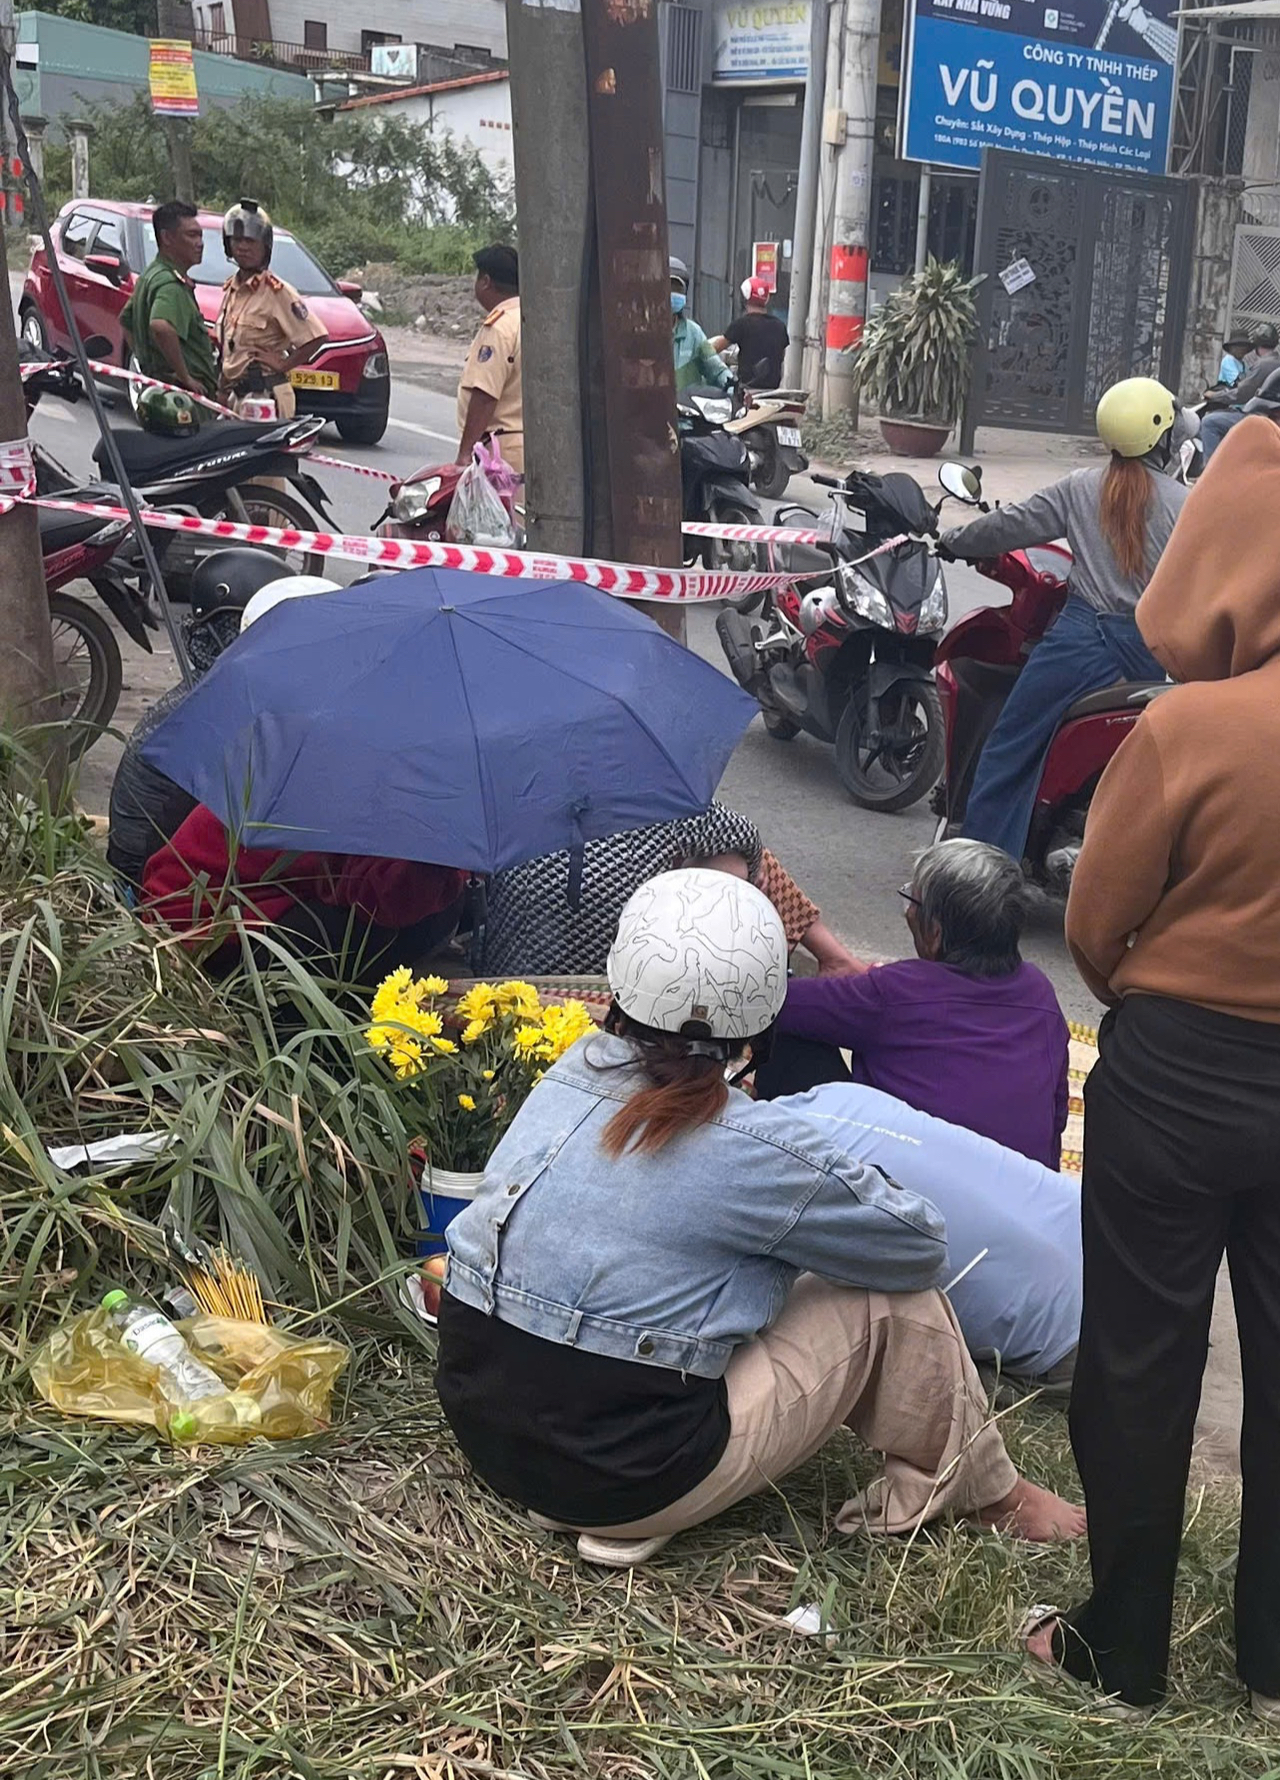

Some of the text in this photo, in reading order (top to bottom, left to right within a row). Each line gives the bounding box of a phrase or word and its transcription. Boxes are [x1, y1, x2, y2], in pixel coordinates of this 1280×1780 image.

[1023, 44, 1158, 82] CÔNG TY TNHH THÉP
[939, 59, 1156, 140] VŨ QUYỀN
